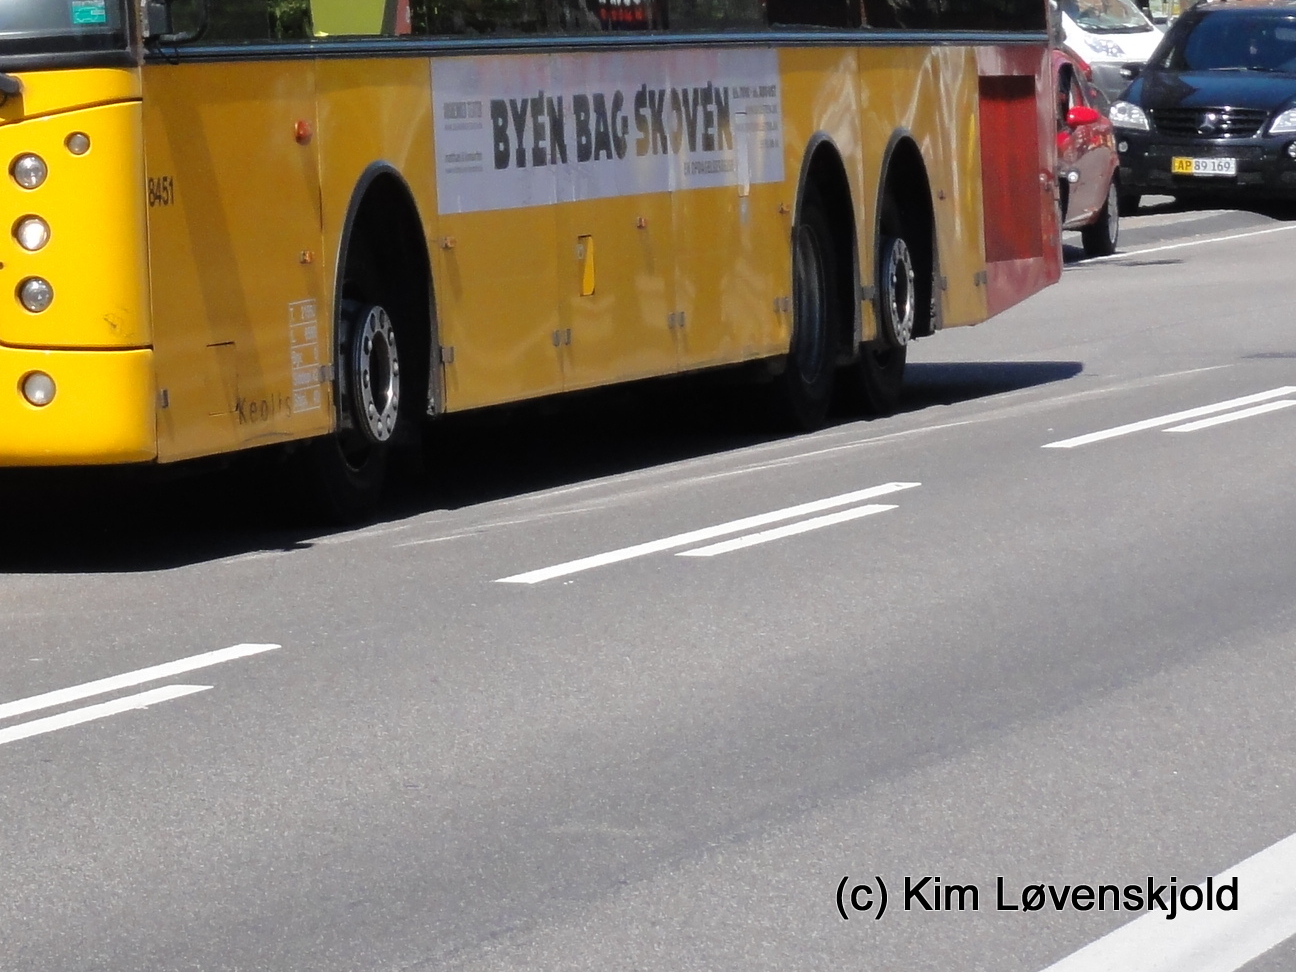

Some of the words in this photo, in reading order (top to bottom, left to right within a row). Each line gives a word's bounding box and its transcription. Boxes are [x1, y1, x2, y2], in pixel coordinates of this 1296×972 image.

[572, 90, 629, 163] BAG
[1178, 161, 1192, 170] AP
[1194, 160, 1208, 171] 89
[1212, 161, 1231, 171] 169
[148, 177, 175, 207] 8451
